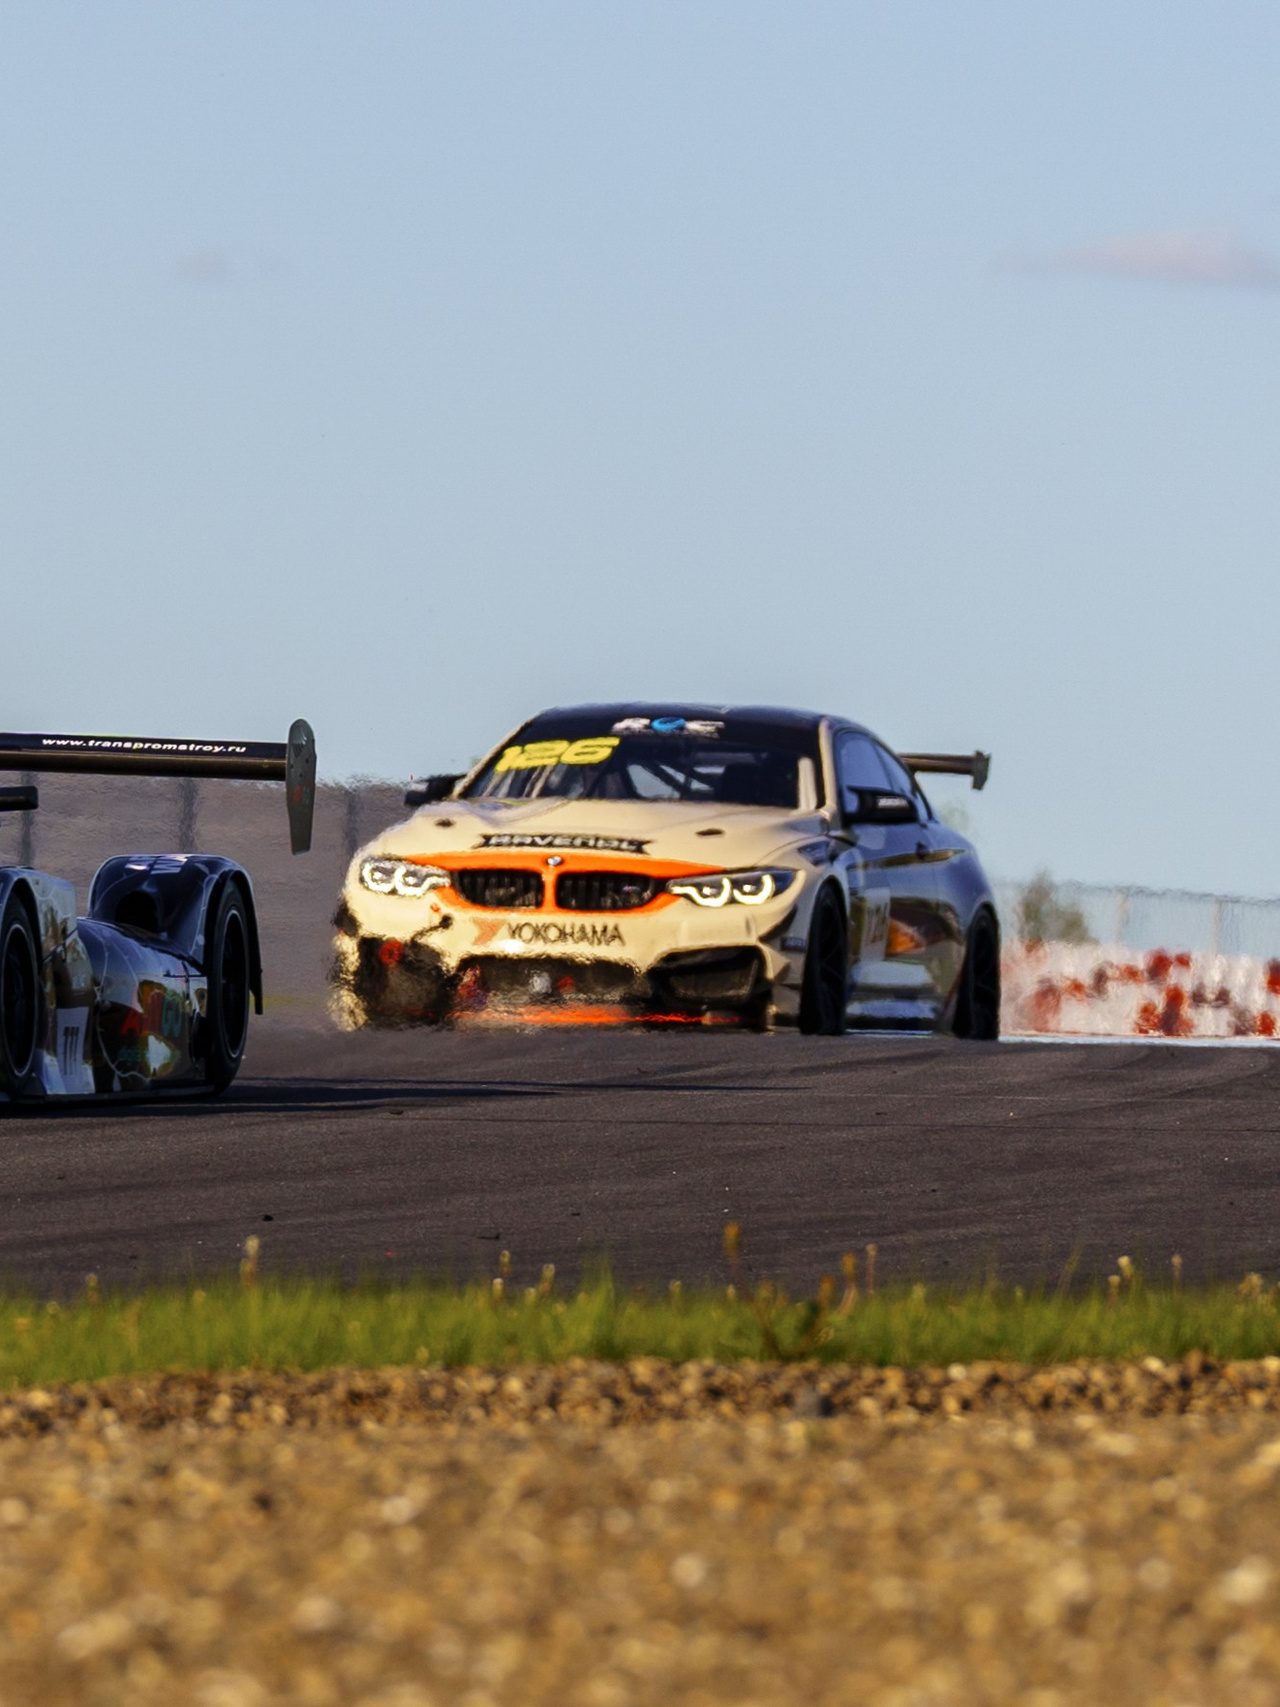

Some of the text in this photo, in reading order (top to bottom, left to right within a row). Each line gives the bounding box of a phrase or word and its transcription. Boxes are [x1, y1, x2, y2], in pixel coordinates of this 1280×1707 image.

[42, 738, 246, 753] www.transpromstroy.ru
[496, 736, 620, 772] 126
[508, 922, 626, 946] YOKOHAMA
